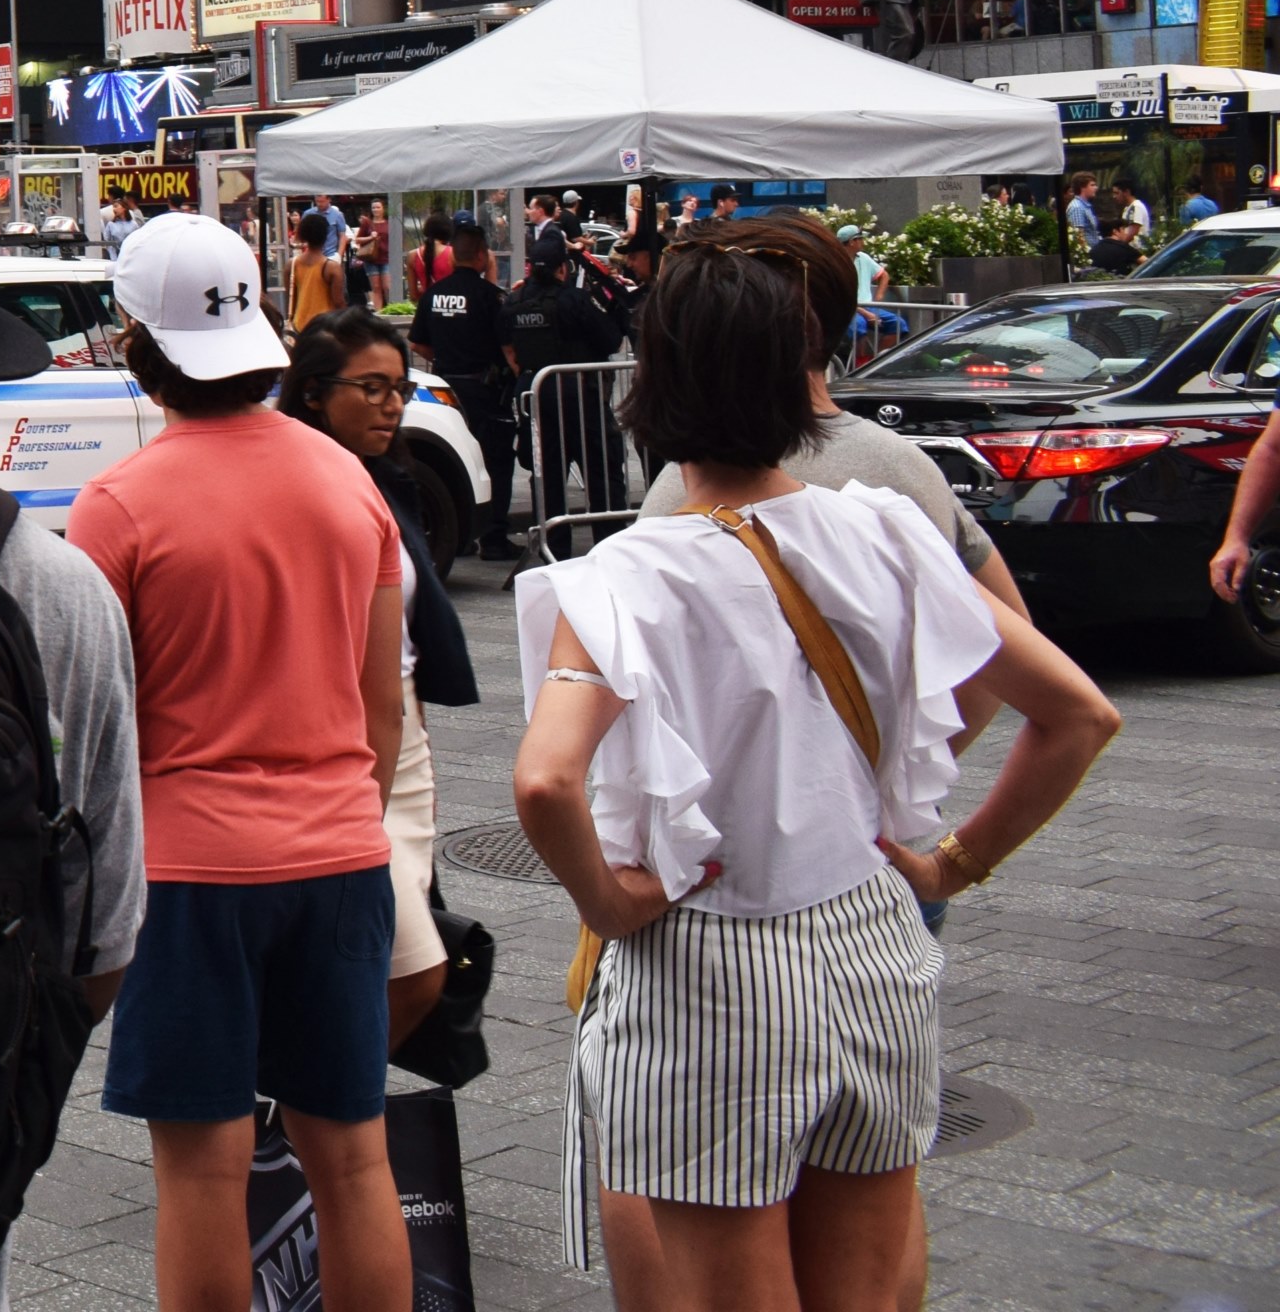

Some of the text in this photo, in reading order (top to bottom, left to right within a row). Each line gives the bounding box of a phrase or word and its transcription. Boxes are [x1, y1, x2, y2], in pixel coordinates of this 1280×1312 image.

[792, 5, 837, 17] OPEN 24
[321, 41, 449, 69] As if we never said goodbye.
[1099, 80, 1154, 89] PEDESTRIAN FLOW ZONE
[1069, 98, 1164, 120] Will JUL
[138, 172, 190, 200] YORK
[433, 295, 467, 309] NYPD
[517, 313, 544, 325] NYPD
[15, 417, 71, 434] COURTESY
[7, 435, 102, 452] PROFESSIONALISM
[0, 454, 48, 471] RESPECT
